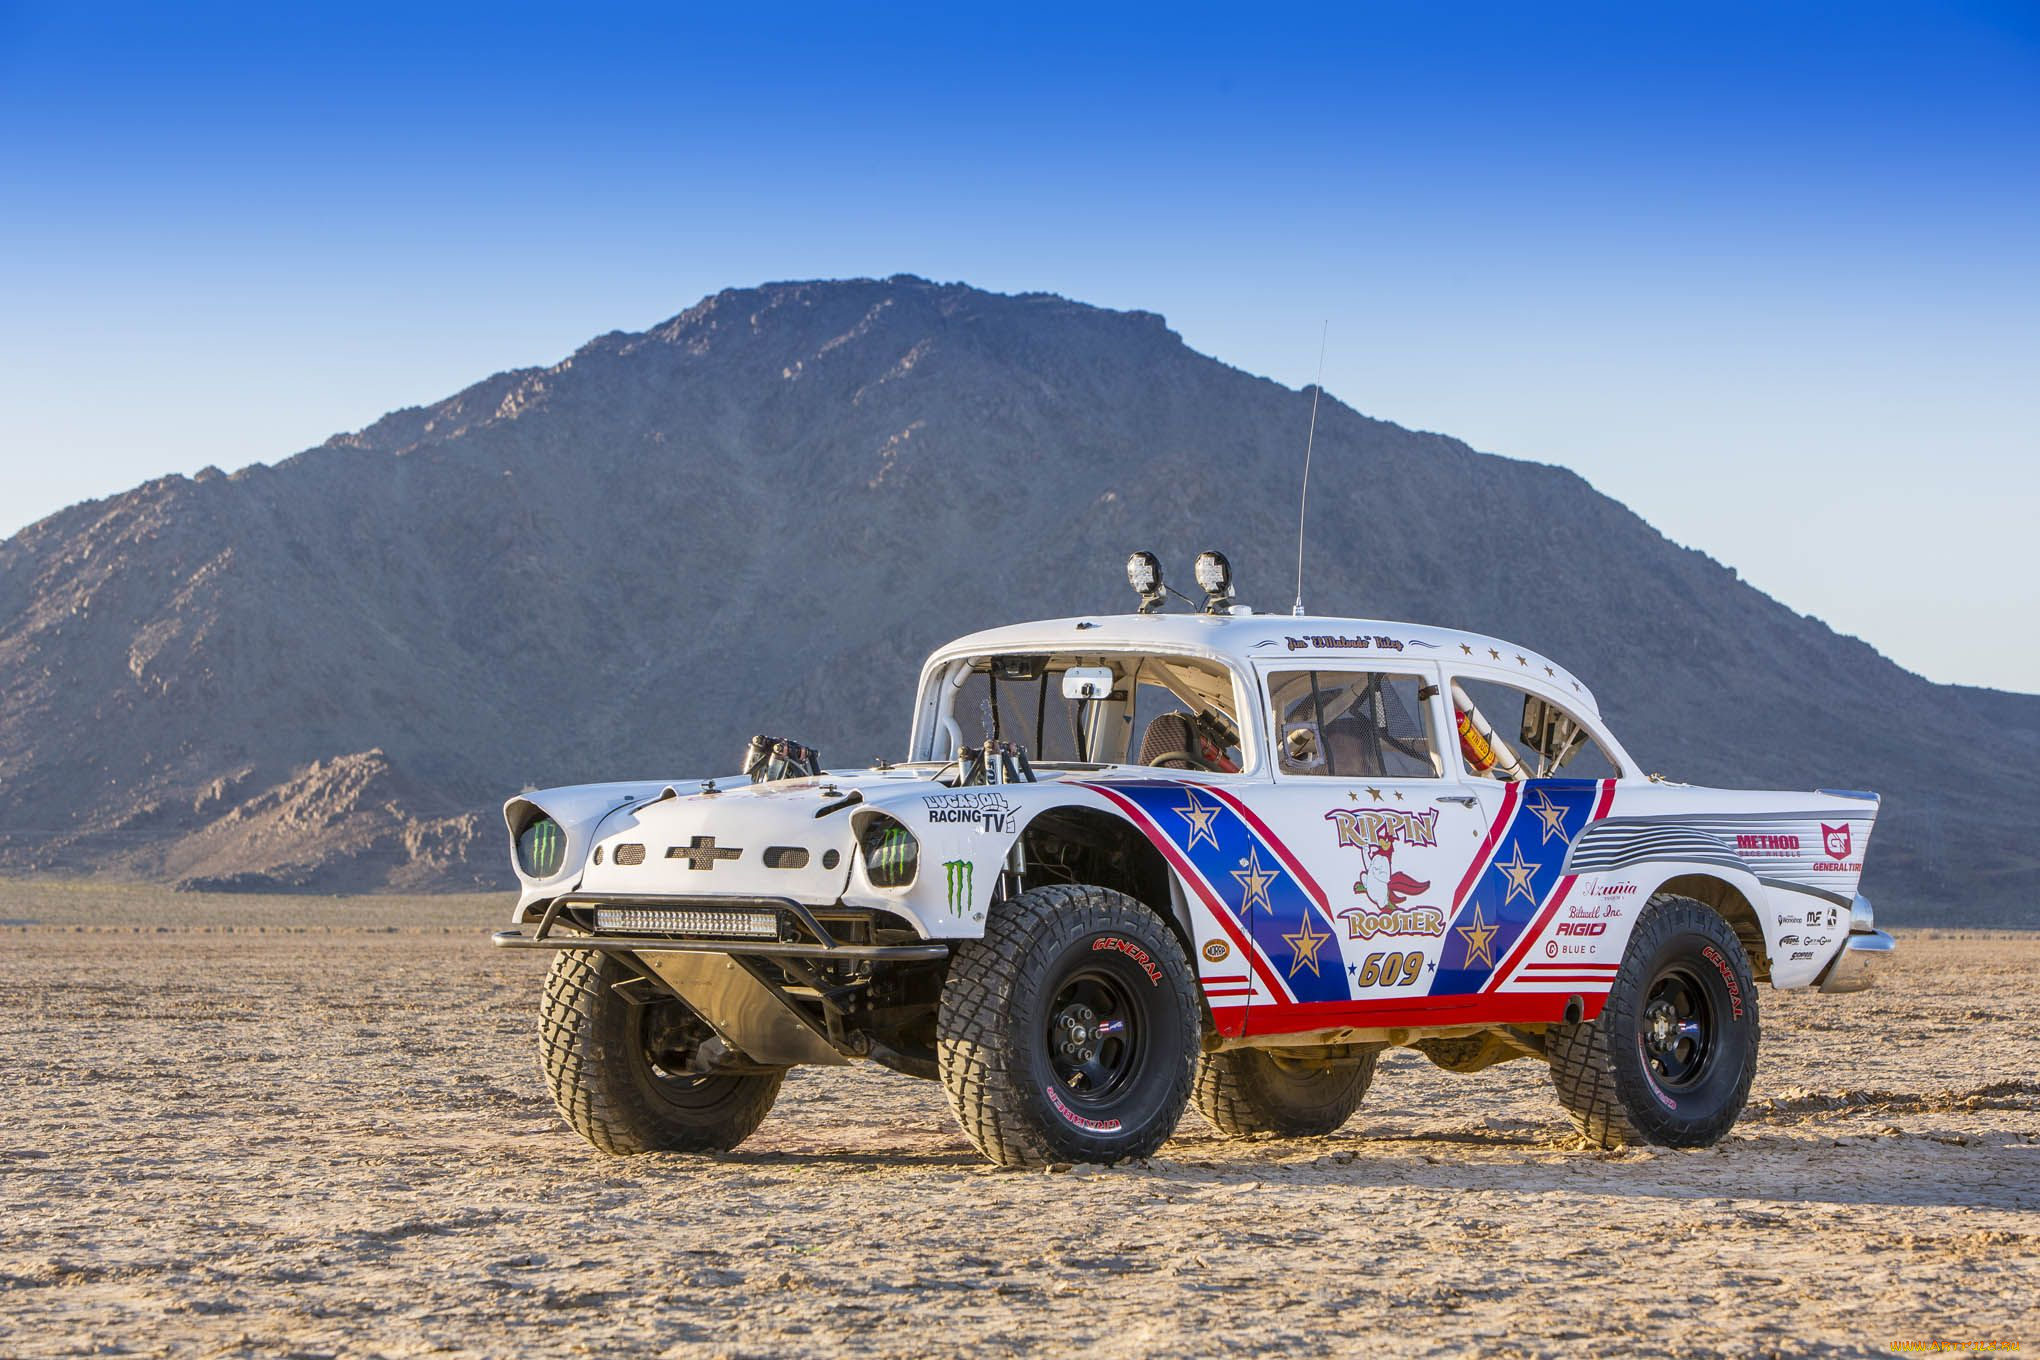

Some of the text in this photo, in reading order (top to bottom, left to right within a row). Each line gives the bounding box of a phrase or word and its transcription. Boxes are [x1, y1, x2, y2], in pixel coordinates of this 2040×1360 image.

[922, 793, 1008, 809] LUCAS OIL
[929, 809, 1005, 832] RACING TV
[1736, 834, 1800, 850] METHOD
[1337, 906, 1446, 941] ROOSTER
[1555, 922, 1607, 937] RIGID
[1093, 937, 1163, 987] GENERAL
[1562, 945, 1596, 954] BLUE C
[1358, 951, 1424, 988] 609
[1702, 946, 1744, 1021] GENERAL
[1046, 1087, 1123, 1131] GRABBER
